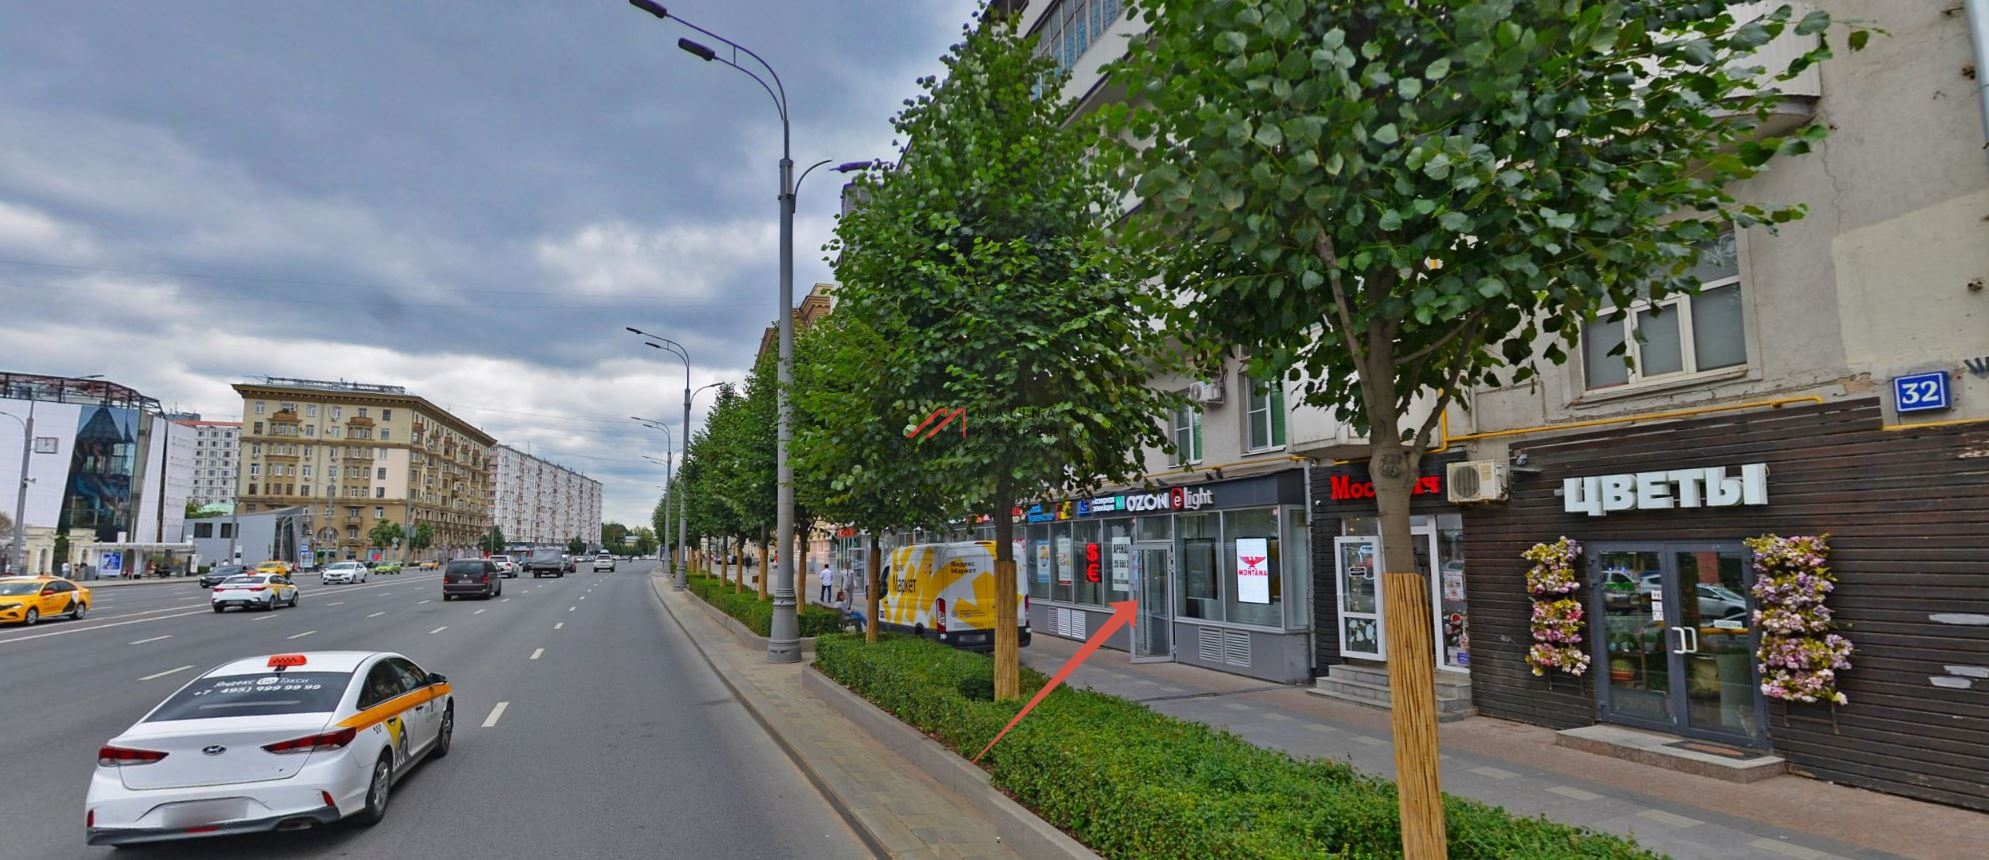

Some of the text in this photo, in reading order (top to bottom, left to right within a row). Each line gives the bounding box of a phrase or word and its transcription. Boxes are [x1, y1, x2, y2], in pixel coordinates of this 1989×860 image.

[1901, 380, 1940, 404] 32
[1330, 475, 1441, 500] Мосич
[1563, 463, 1768, 516] ЦВЕТЫ
[1126, 492, 1170, 511] OZON
